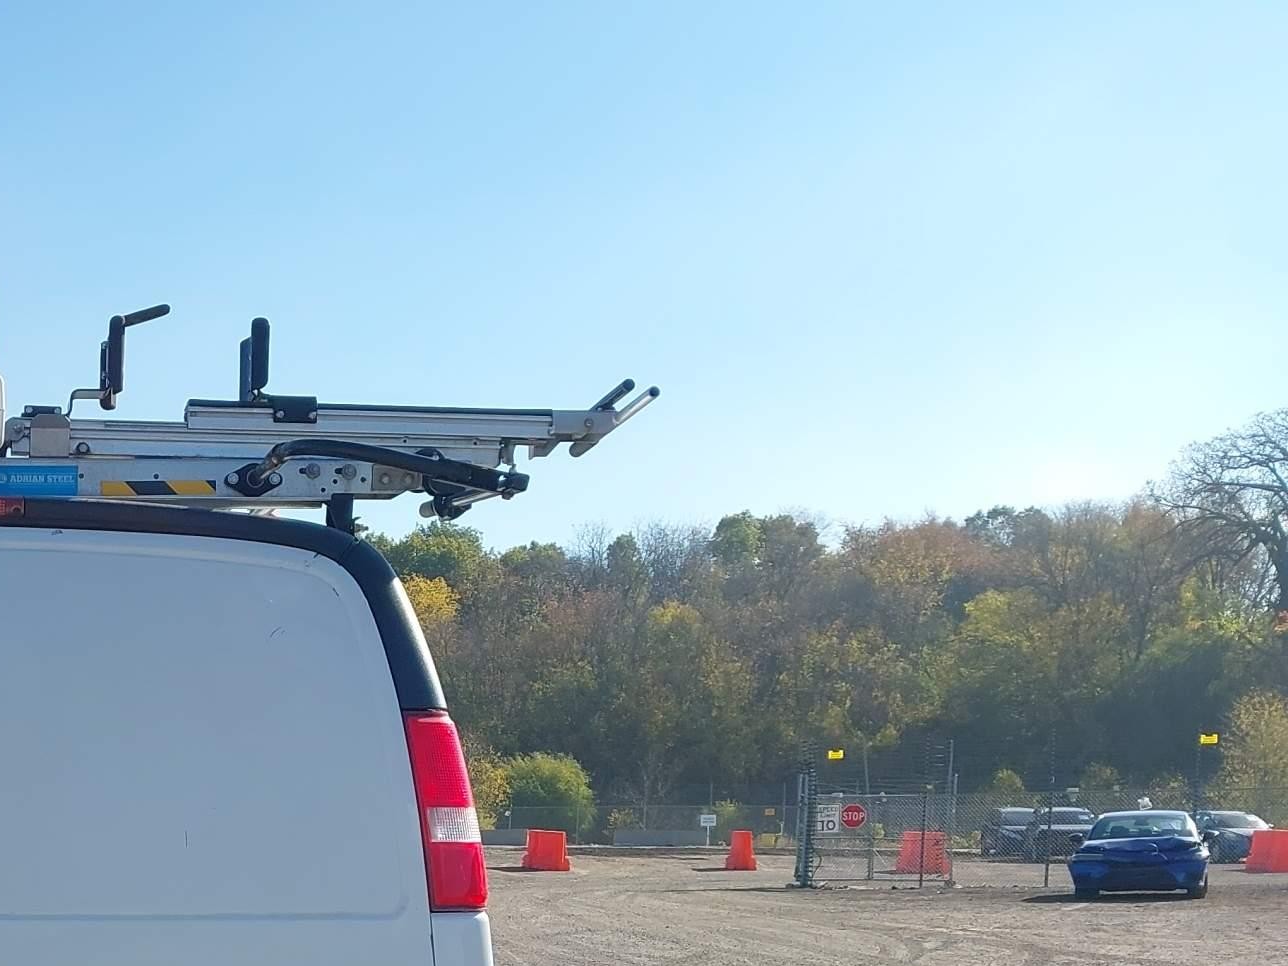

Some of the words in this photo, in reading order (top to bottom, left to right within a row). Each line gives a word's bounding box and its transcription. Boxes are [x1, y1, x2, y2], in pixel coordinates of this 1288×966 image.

[9, 474, 45, 483] ADRIAN
[47, 474, 75, 483] STEEL
[843, 811, 865, 821] STOP
[820, 820, 836, 831] 10
